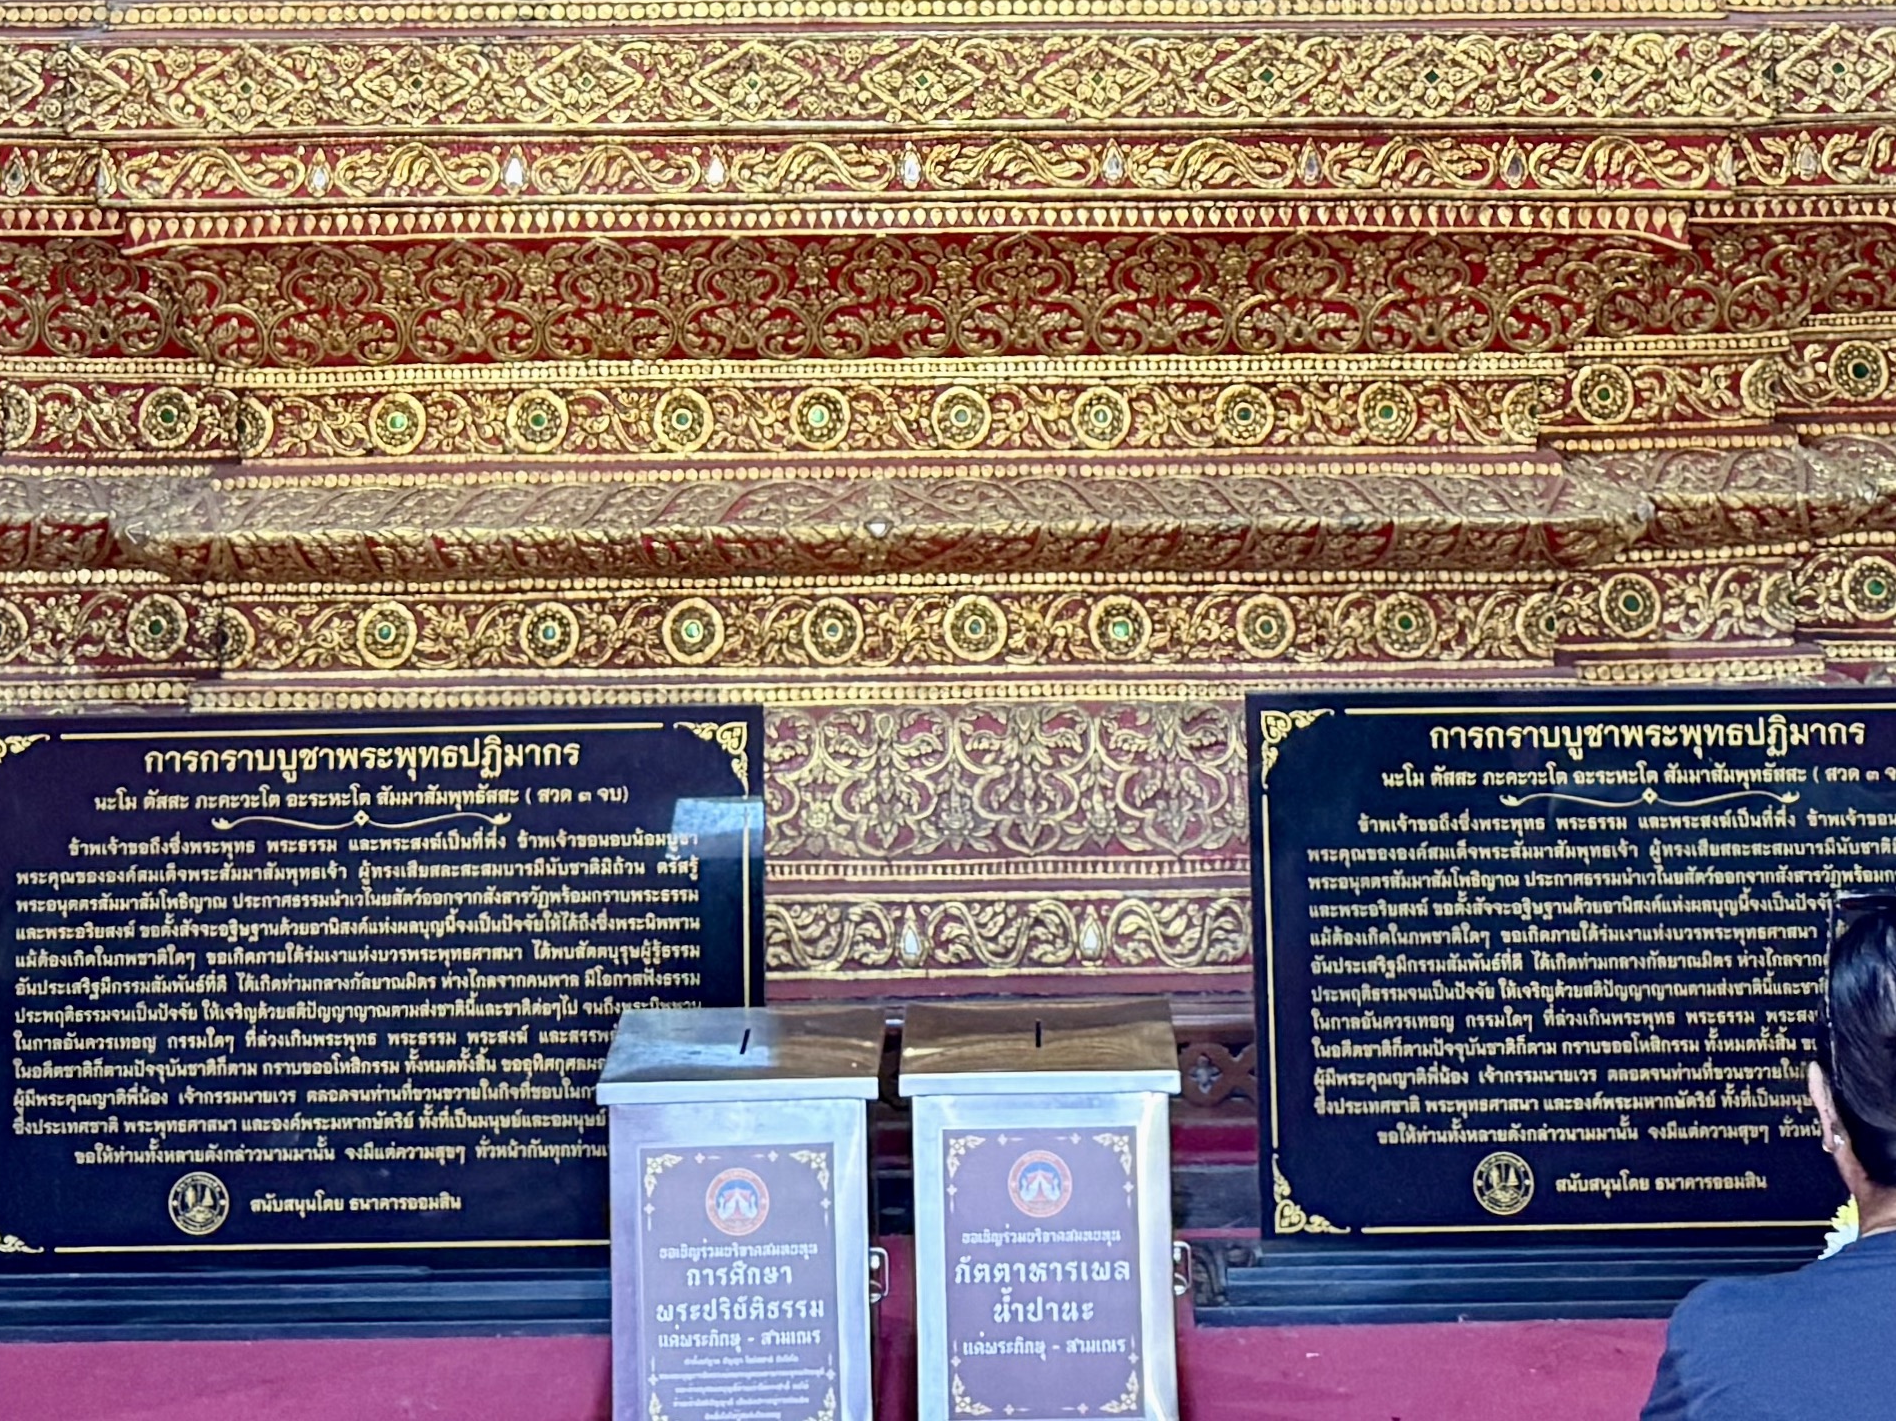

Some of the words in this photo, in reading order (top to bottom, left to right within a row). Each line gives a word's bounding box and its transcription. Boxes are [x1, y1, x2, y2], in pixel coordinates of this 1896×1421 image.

[1429, 713, 1865, 760] การกราบบูชาพระพุทธปฏิมากร
[144, 734, 580, 784] การกราบบูชาพระพุทธปฏิมากร
[1380, 762, 1425, 787] นะโม
[1429, 764, 1477, 786] ตัสสะ
[1481, 761, 1569, 786] ภะคะวะโต
[1571, 760, 1659, 785] อะระหะโต
[1662, 761, 1807, 791] สัมมาสัมพุทธัสสะ
[93, 787, 137, 811] นะโม
[142, 788, 190, 810] ตัสสะ
[193, 784, 281, 809] ภะคะวะโต
[284, 783, 371, 808] อะระหะโต
[375, 782, 520, 813] สัมมาสัมพุทธัสสะ
[1554, 816, 1628, 831] พระธรรม
[265, 838, 338, 853] พระธรรม
[1684, 1011, 1755, 1026] พระธรรม
[1764, 1008, 1818, 1025] พระสง
[386, 1030, 457, 1045] พระธรรม
[465, 1021, 528, 1044] พระสงฆ์
[1423, 1095, 1539, 1119] พระพุทธศาสนา
[122, 1116, 237, 1140] พระพุทธศาสนา
[1554, 1168, 1651, 1198] สนับสนุนโดย
[1653, 1169, 1768, 1191] ธนาคารออมสิน
[249, 1189, 345, 1219] สนับสนุนโดย
[347, 1189, 462, 1211] ธนาคารออมสิน
[686, 1260, 793, 1287] การศึกษา
[954, 1255, 1131, 1284] ภัตตาหารเพล
[656, 1295, 825, 1323] พระปริยัติธรรม
[992, 1286, 1094, 1323] น้ำปานะ
[761, 1329, 821, 1346] สามเณร
[1066, 1337, 1126, 1354] สามเณร
